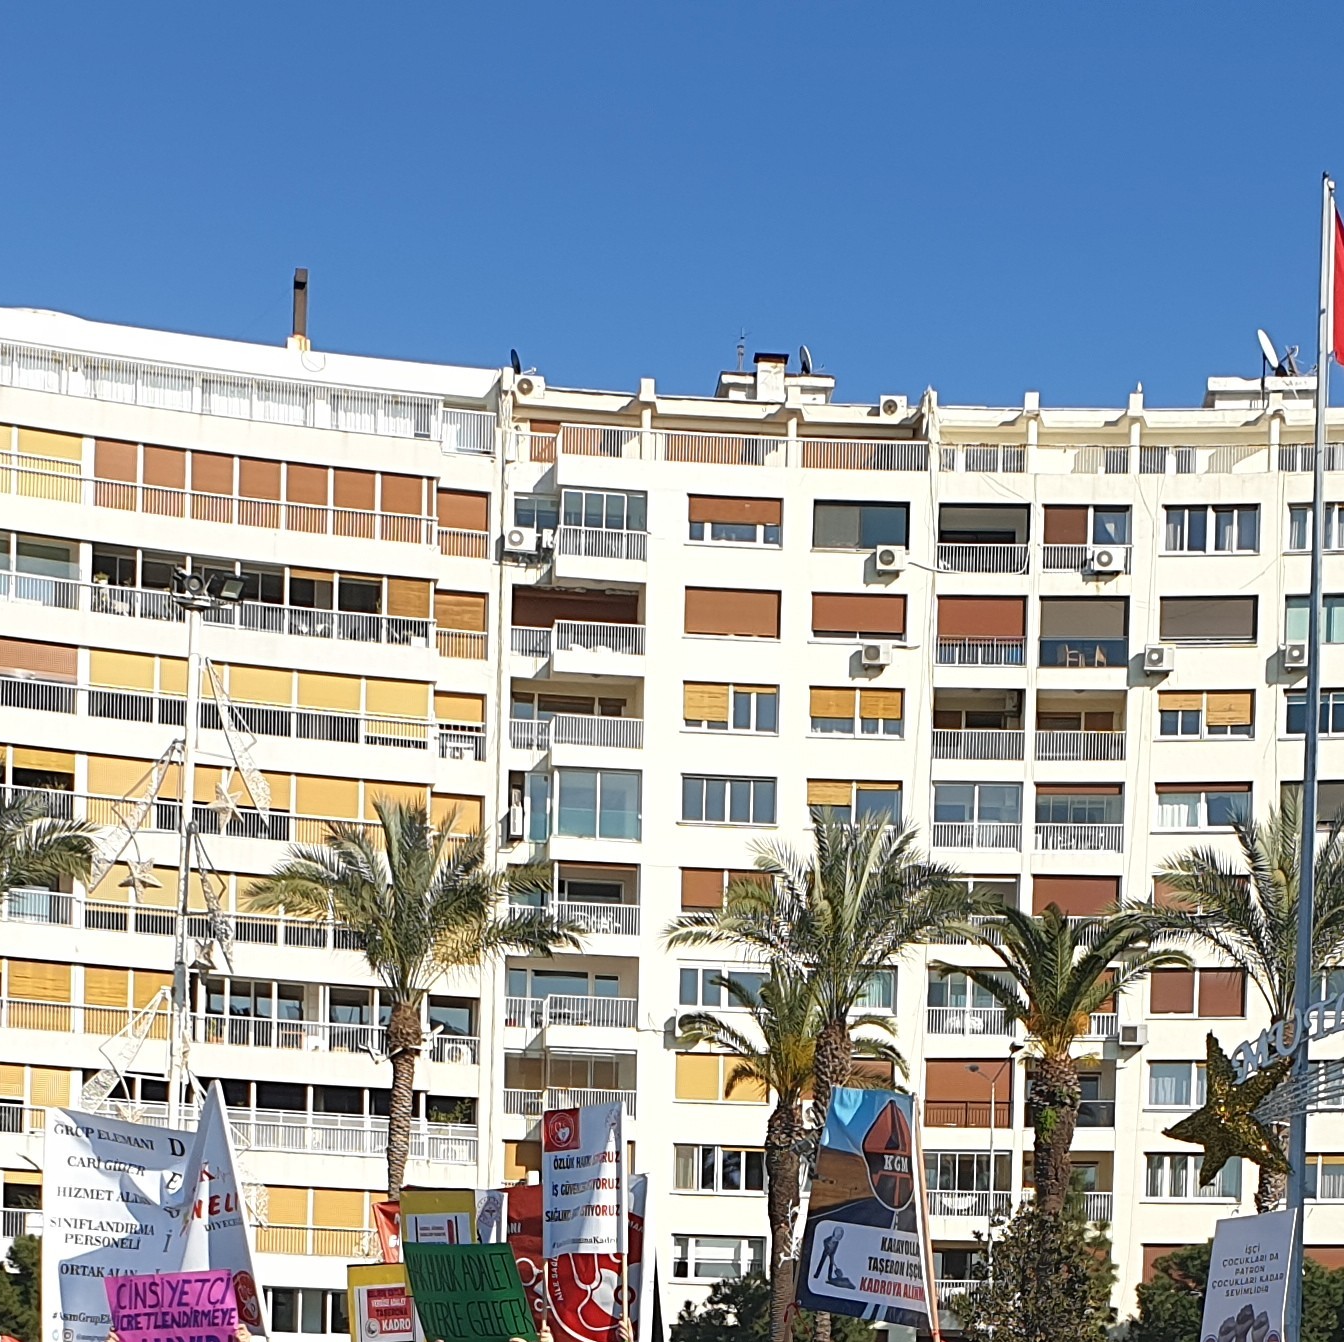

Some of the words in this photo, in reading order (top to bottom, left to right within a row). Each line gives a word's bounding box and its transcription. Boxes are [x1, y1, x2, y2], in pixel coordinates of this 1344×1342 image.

[54, 1123, 95, 1139] GRUP
[97, 1129, 155, 1151] ELEMANI
[884, 1155, 909, 1173] KGM
[57, 1186, 114, 1202] HİZMET
[50, 1217, 155, 1236] SINIFLANDIRMA
[64, 1233, 142, 1251] PERSONELİ
[60, 1263, 106, 1279] ORTAK
[868, 1257, 904, 1276] TAŞERON
[1222, 1256, 1267, 1268] ÇOCUKLARI
[1235, 1265, 1265, 1276] PATRON
[860, 1277, 903, 1297] KADROYA
[1212, 1277, 1257, 1290] ÇOCUKLARI
[1259, 1272, 1285, 1282] KADAR
[115, 1273, 233, 1311] CİNSİYETÇİ
[382, 1318, 411, 1331] KADRO
